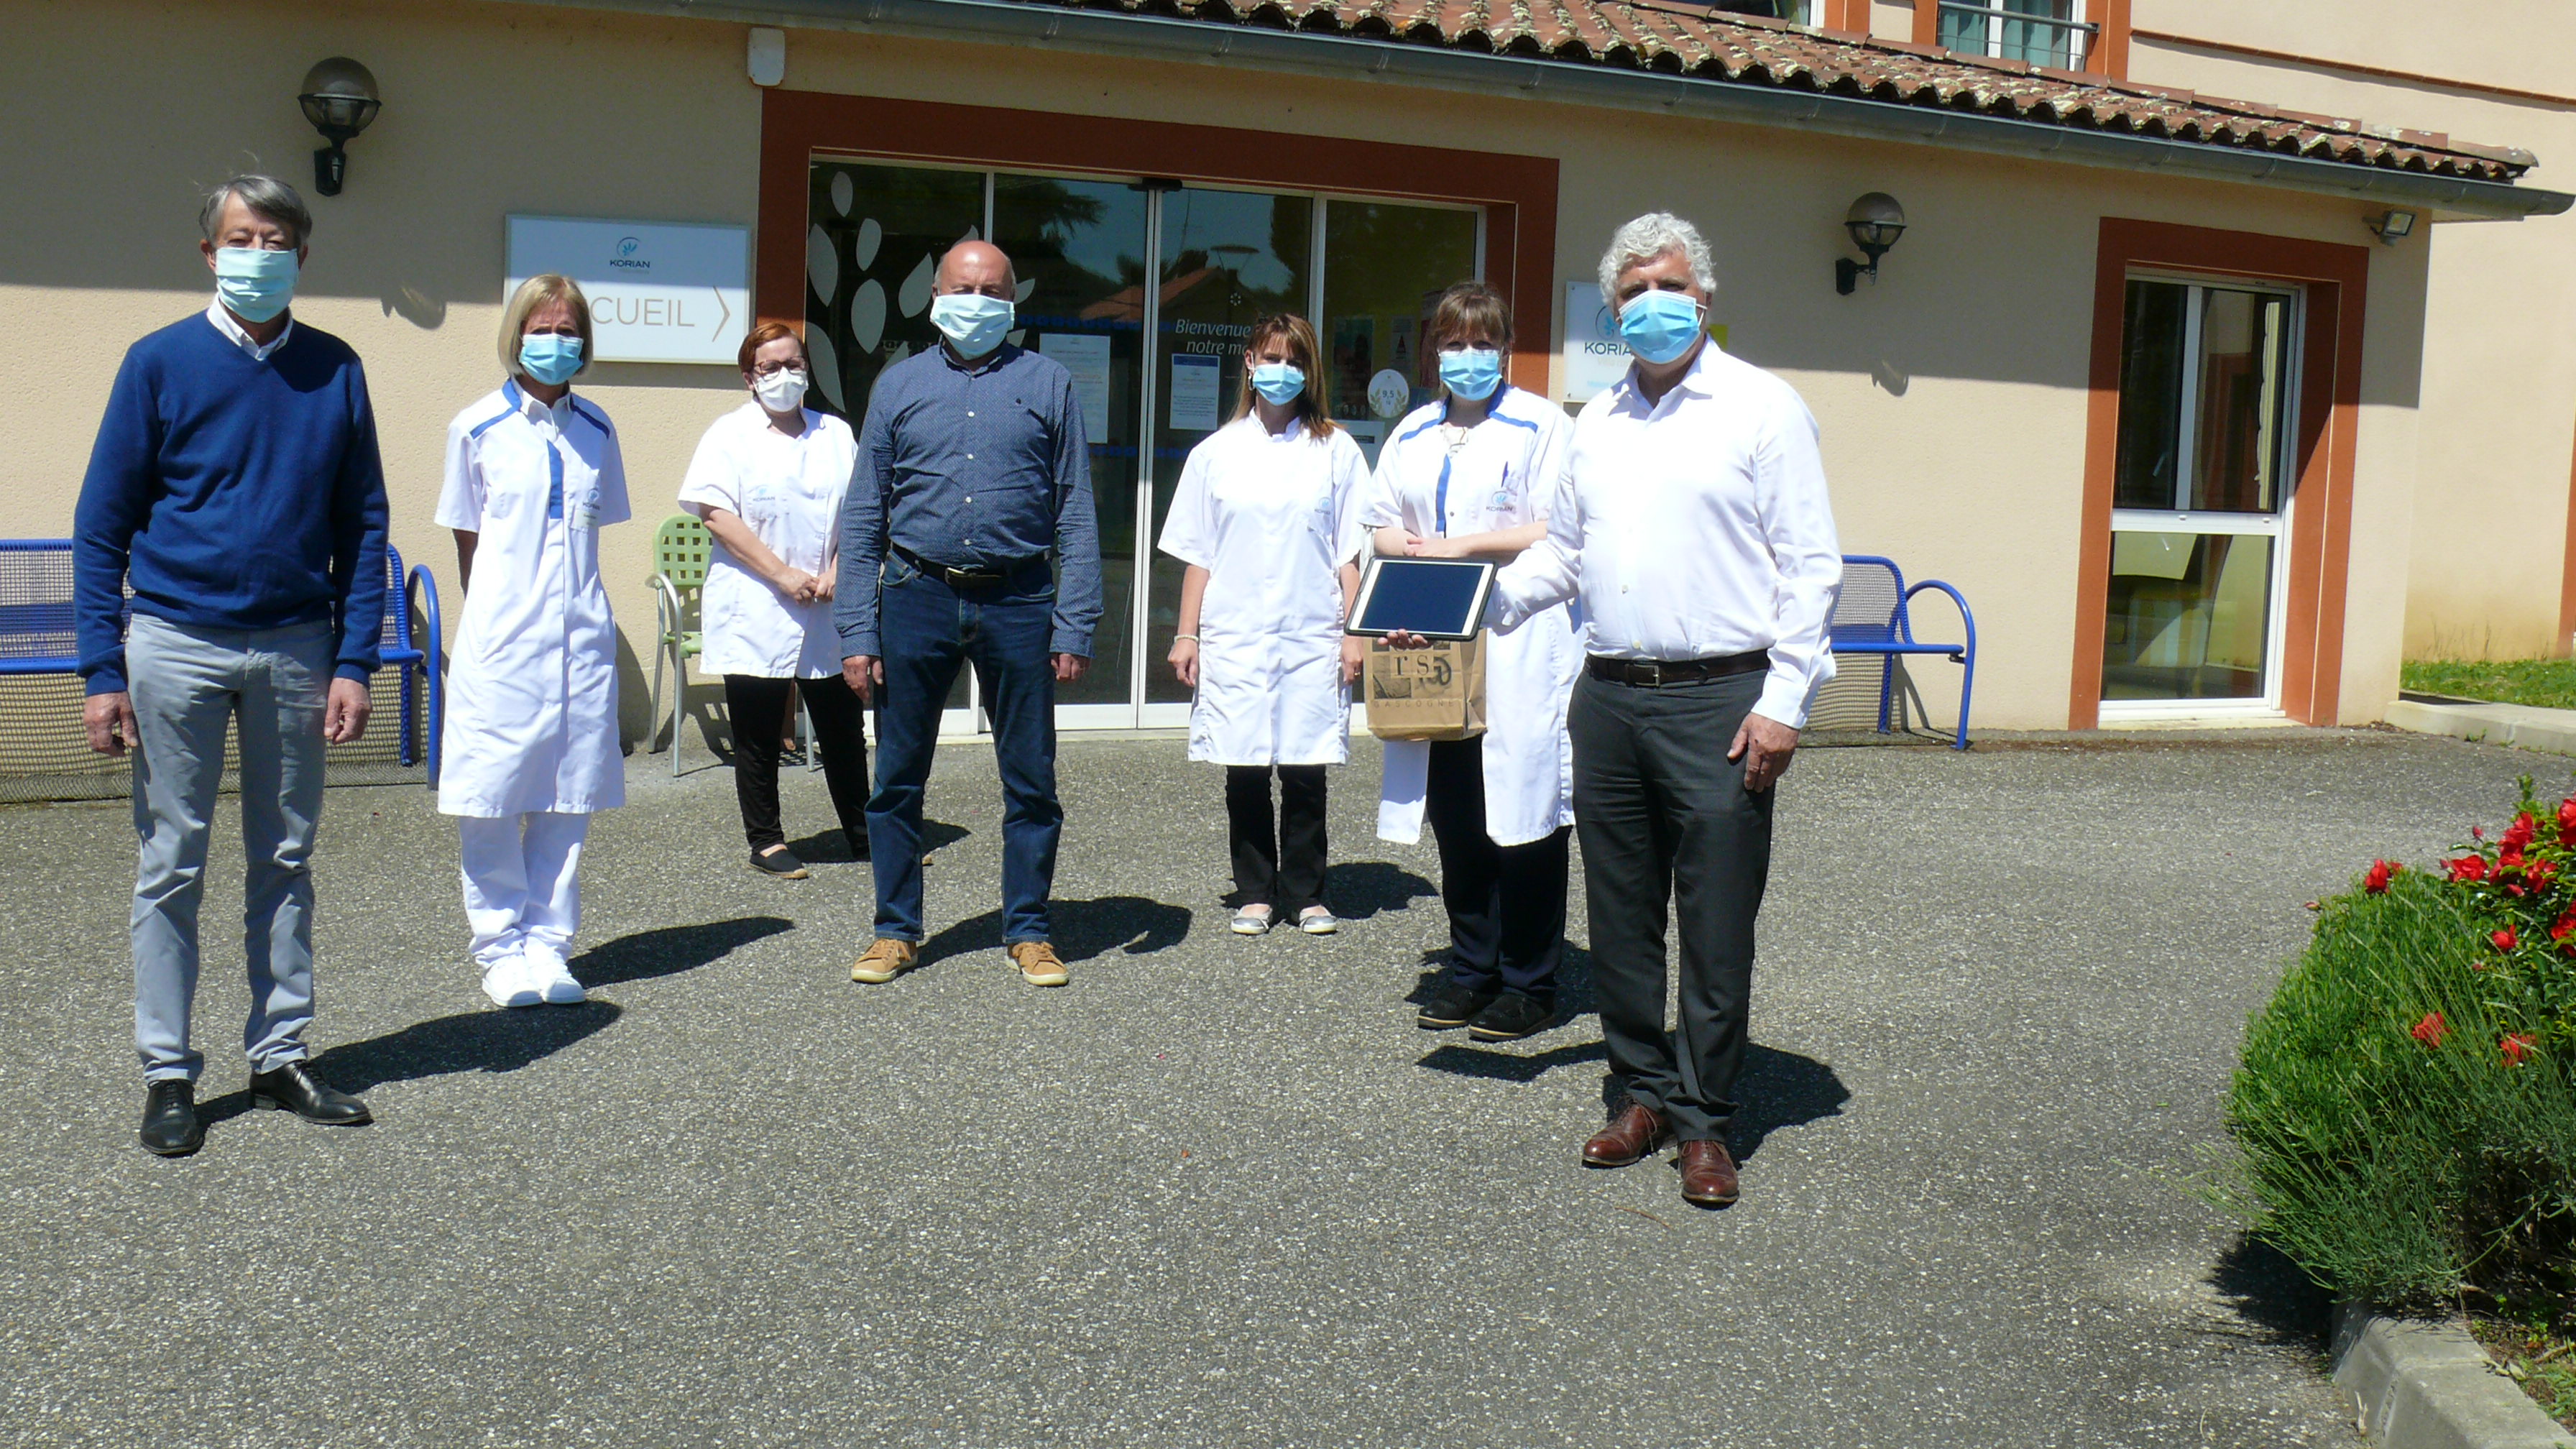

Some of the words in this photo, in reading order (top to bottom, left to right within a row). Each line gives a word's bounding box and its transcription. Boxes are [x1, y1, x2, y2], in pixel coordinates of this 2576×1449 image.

[610, 259, 650, 269] KORIAN
[589, 296, 695, 327] CUEIL
[1175, 318, 1251, 338] Bienvenue
[1186, 339, 1225, 355] notre
[1584, 341, 1632, 356] KORIA
[1374, 700, 1455, 709] GASCOGNE
